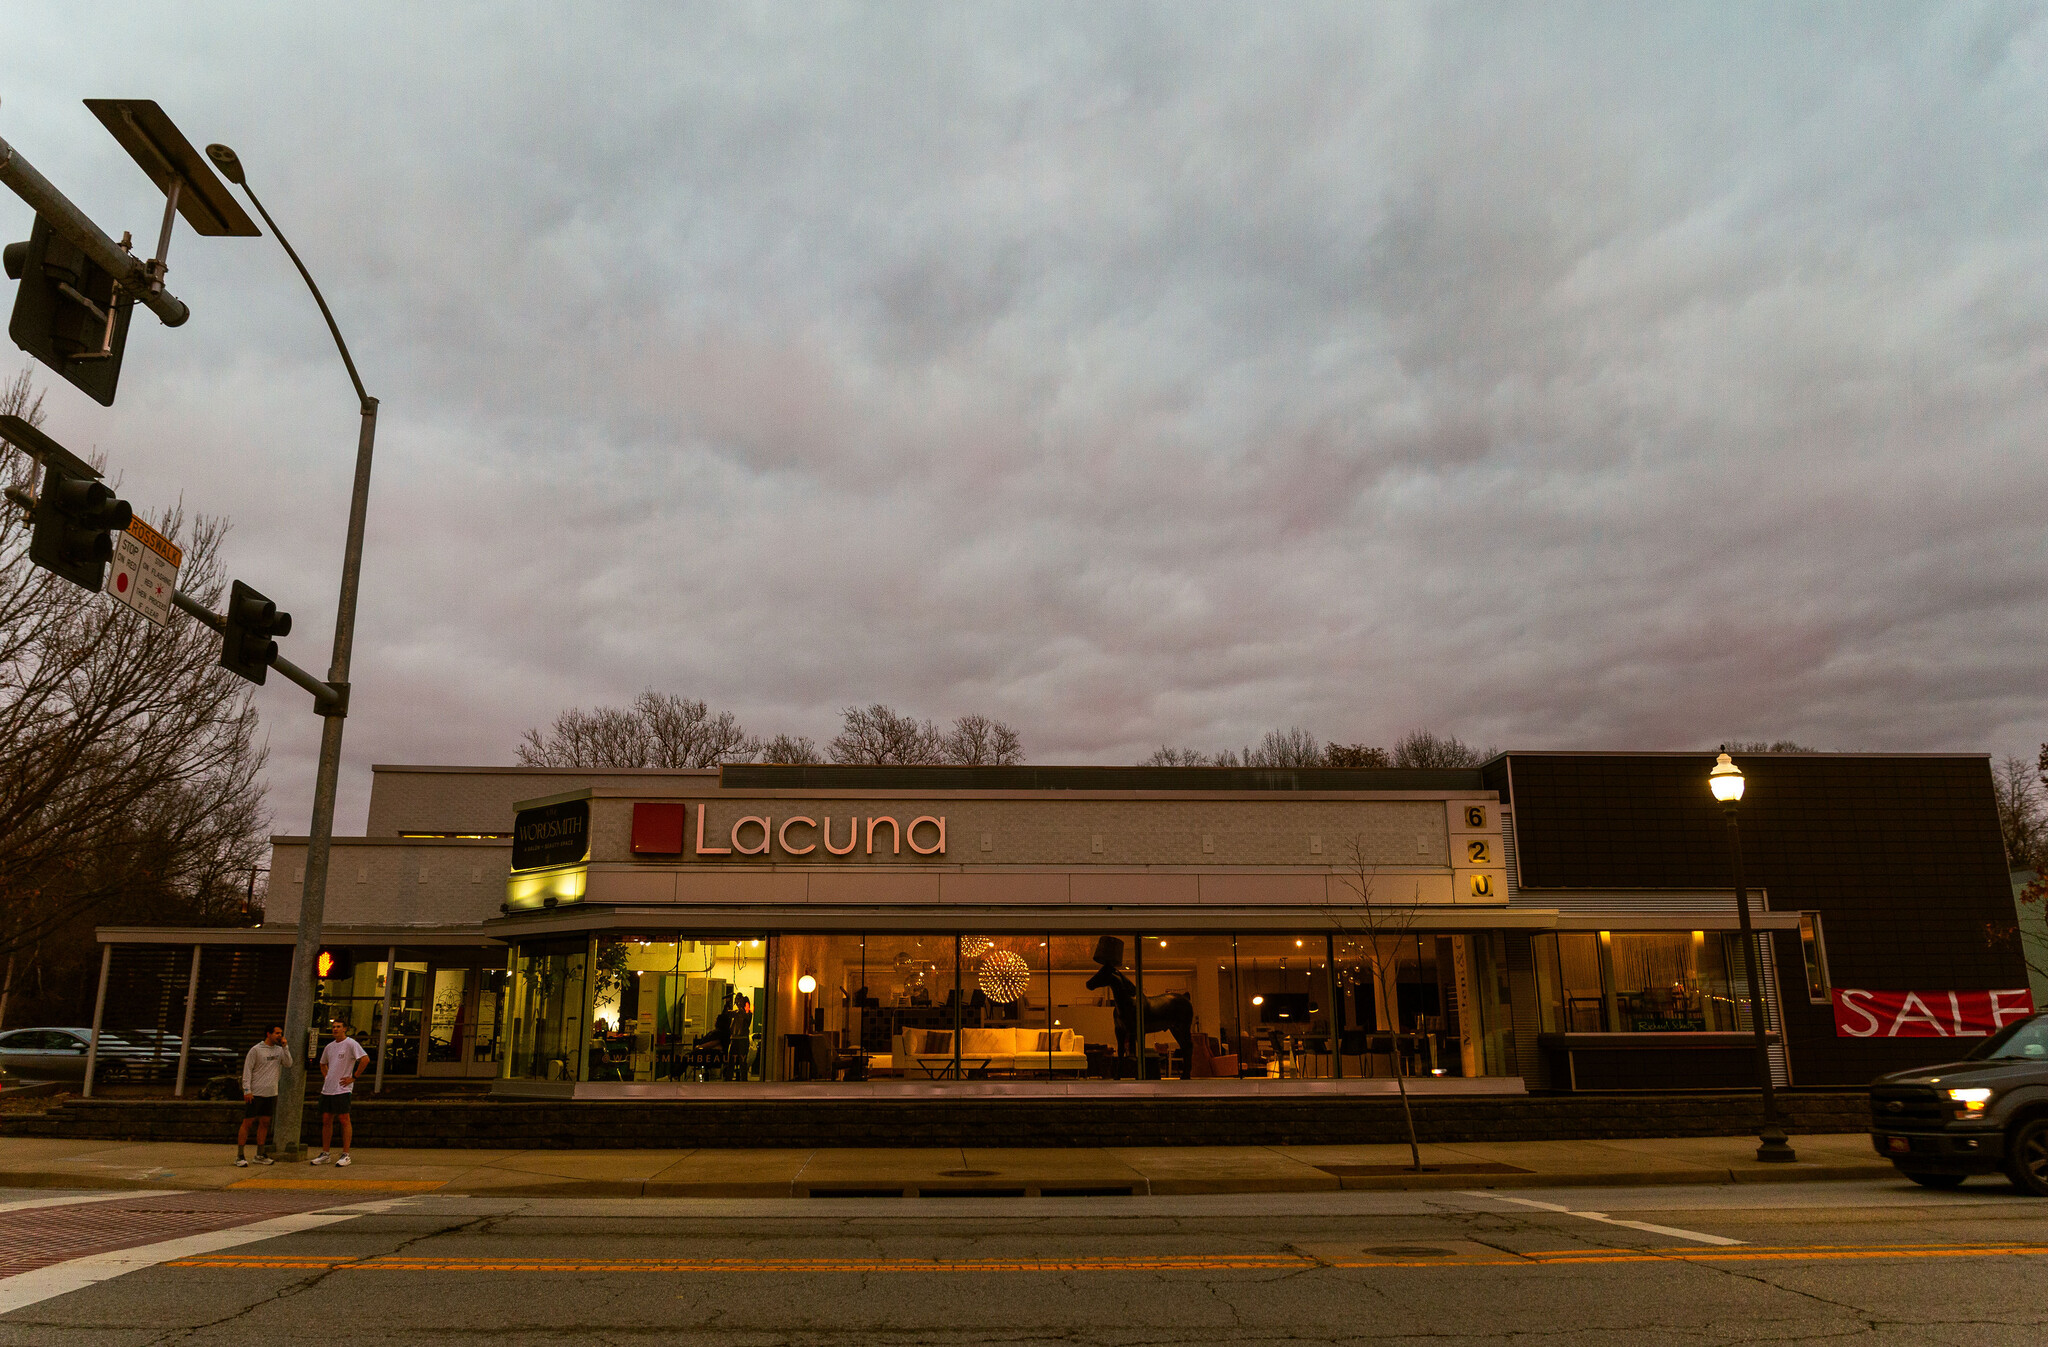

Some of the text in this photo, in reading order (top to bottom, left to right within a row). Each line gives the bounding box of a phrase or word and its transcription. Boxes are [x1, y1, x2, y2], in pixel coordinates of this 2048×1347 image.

[122, 539, 139, 556] STOP
[117, 552, 137, 571] ON RED
[154, 557, 165, 568] STOP
[142, 562, 172, 586] ON FLASHING
[144, 577, 153, 588] RED
[136, 587, 167, 612] THEN PROCEED
[138, 602, 159, 619] IF CLEAR
[520, 817, 582, 840] WORDSMITH
[696, 804, 946, 855] Lacuna
